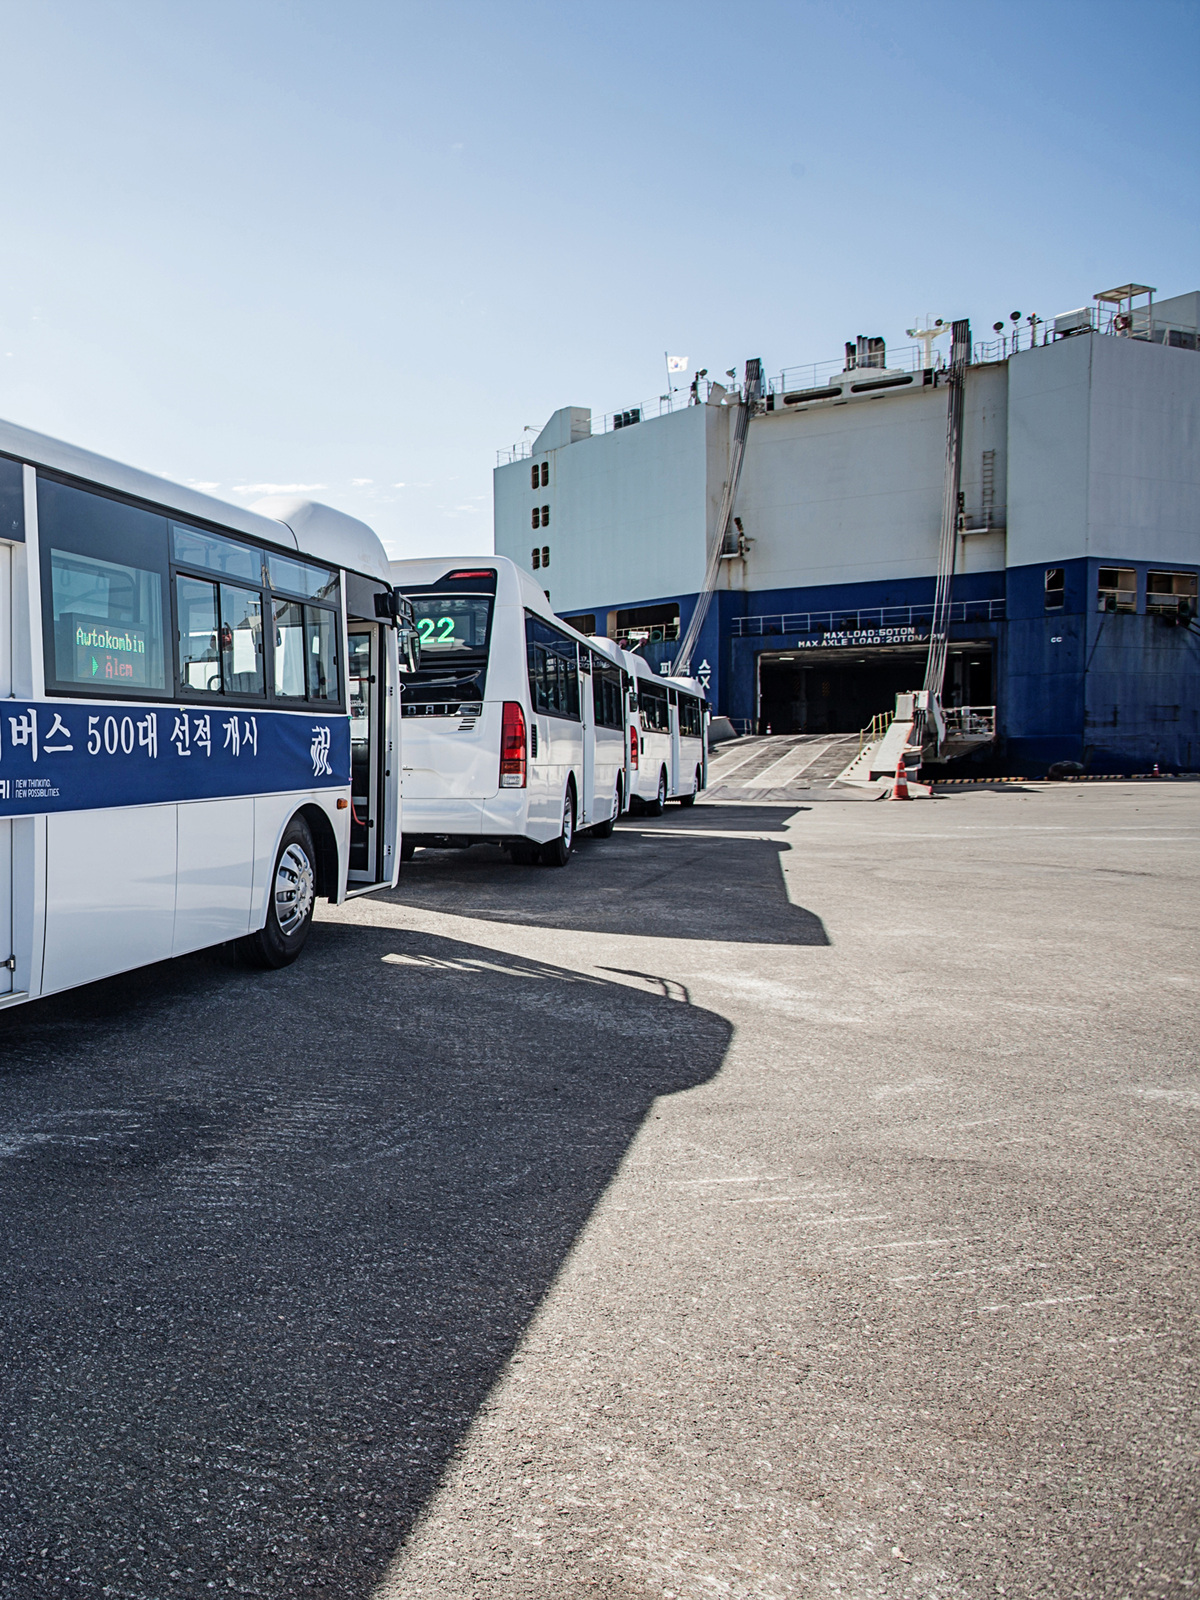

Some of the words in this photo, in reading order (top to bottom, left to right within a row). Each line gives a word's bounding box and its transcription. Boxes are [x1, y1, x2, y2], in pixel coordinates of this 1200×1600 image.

[76, 626, 145, 653] Awtokombin
[417, 617, 455, 644] 22
[87, 712, 158, 759] 500대
[170, 713, 212, 757] 선적
[222, 715, 259, 757] 개시
[310, 726, 333, 777] 祝
[15, 779, 27, 788] NEW
[15, 788, 27, 798] NEW
